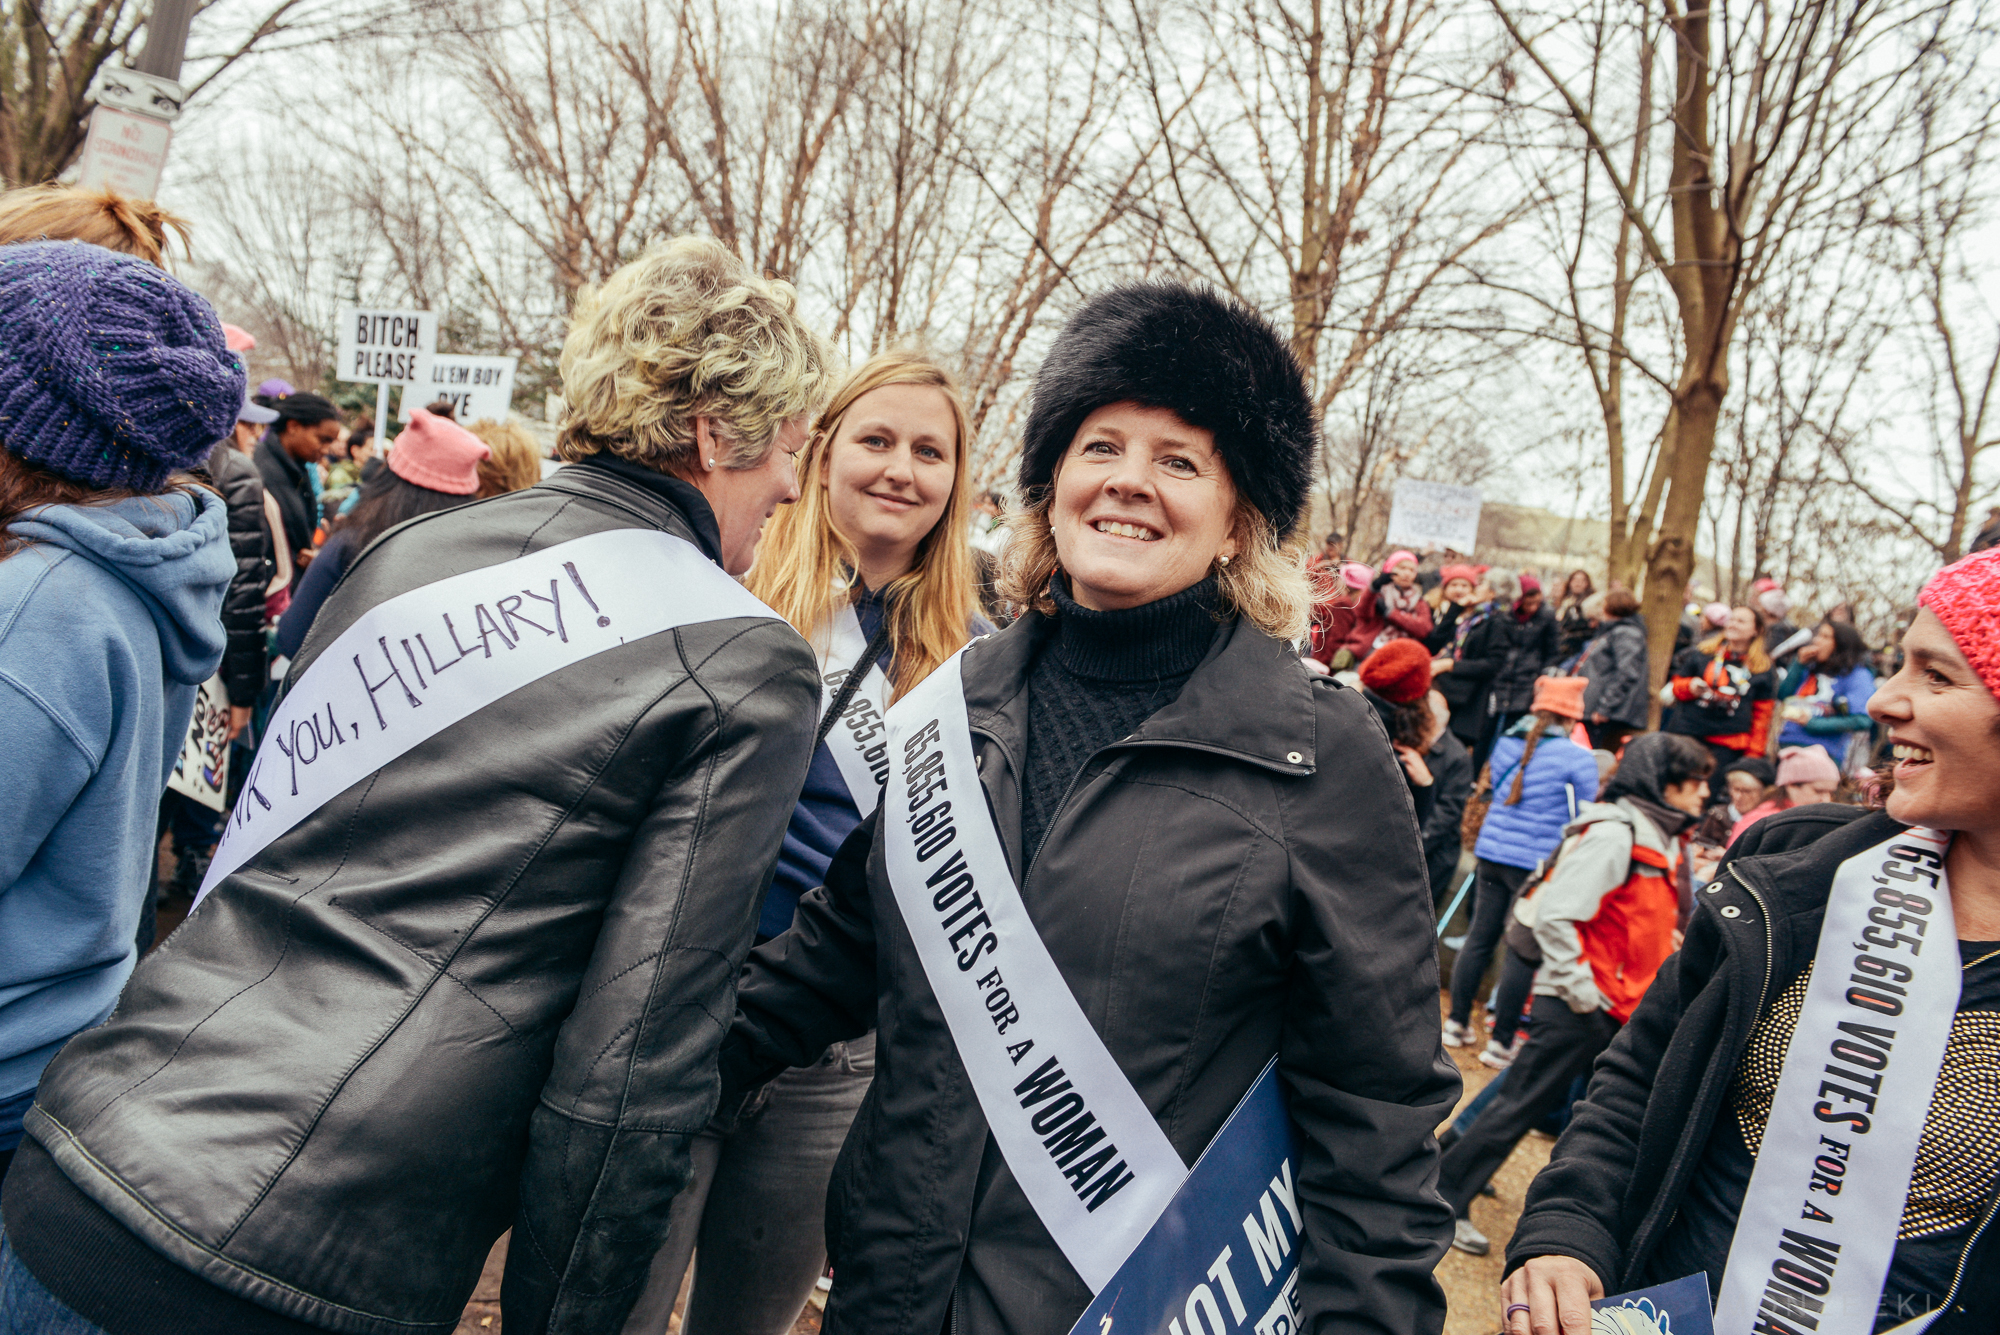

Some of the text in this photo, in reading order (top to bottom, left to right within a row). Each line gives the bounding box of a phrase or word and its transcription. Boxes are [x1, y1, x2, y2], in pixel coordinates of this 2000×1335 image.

[121, 125, 143, 143] NO
[355, 351, 416, 381] PLEASE
[473, 367, 503, 386] BOY
[276, 702, 360, 797] YOU,
[353, 561, 612, 731] HILLARY!
[904, 718, 1135, 1214] 65,855,610 VOTES FOR A WOMAN
[1845, 842, 1943, 1018] 65,855,610
[1813, 1020, 1898, 1135] VOTES
[1808, 1133, 1851, 1197] FOR
[1168, 1244, 1248, 1335] OT
[1241, 1157, 1304, 1287] MY
[1800, 1199, 1834, 1224] A
